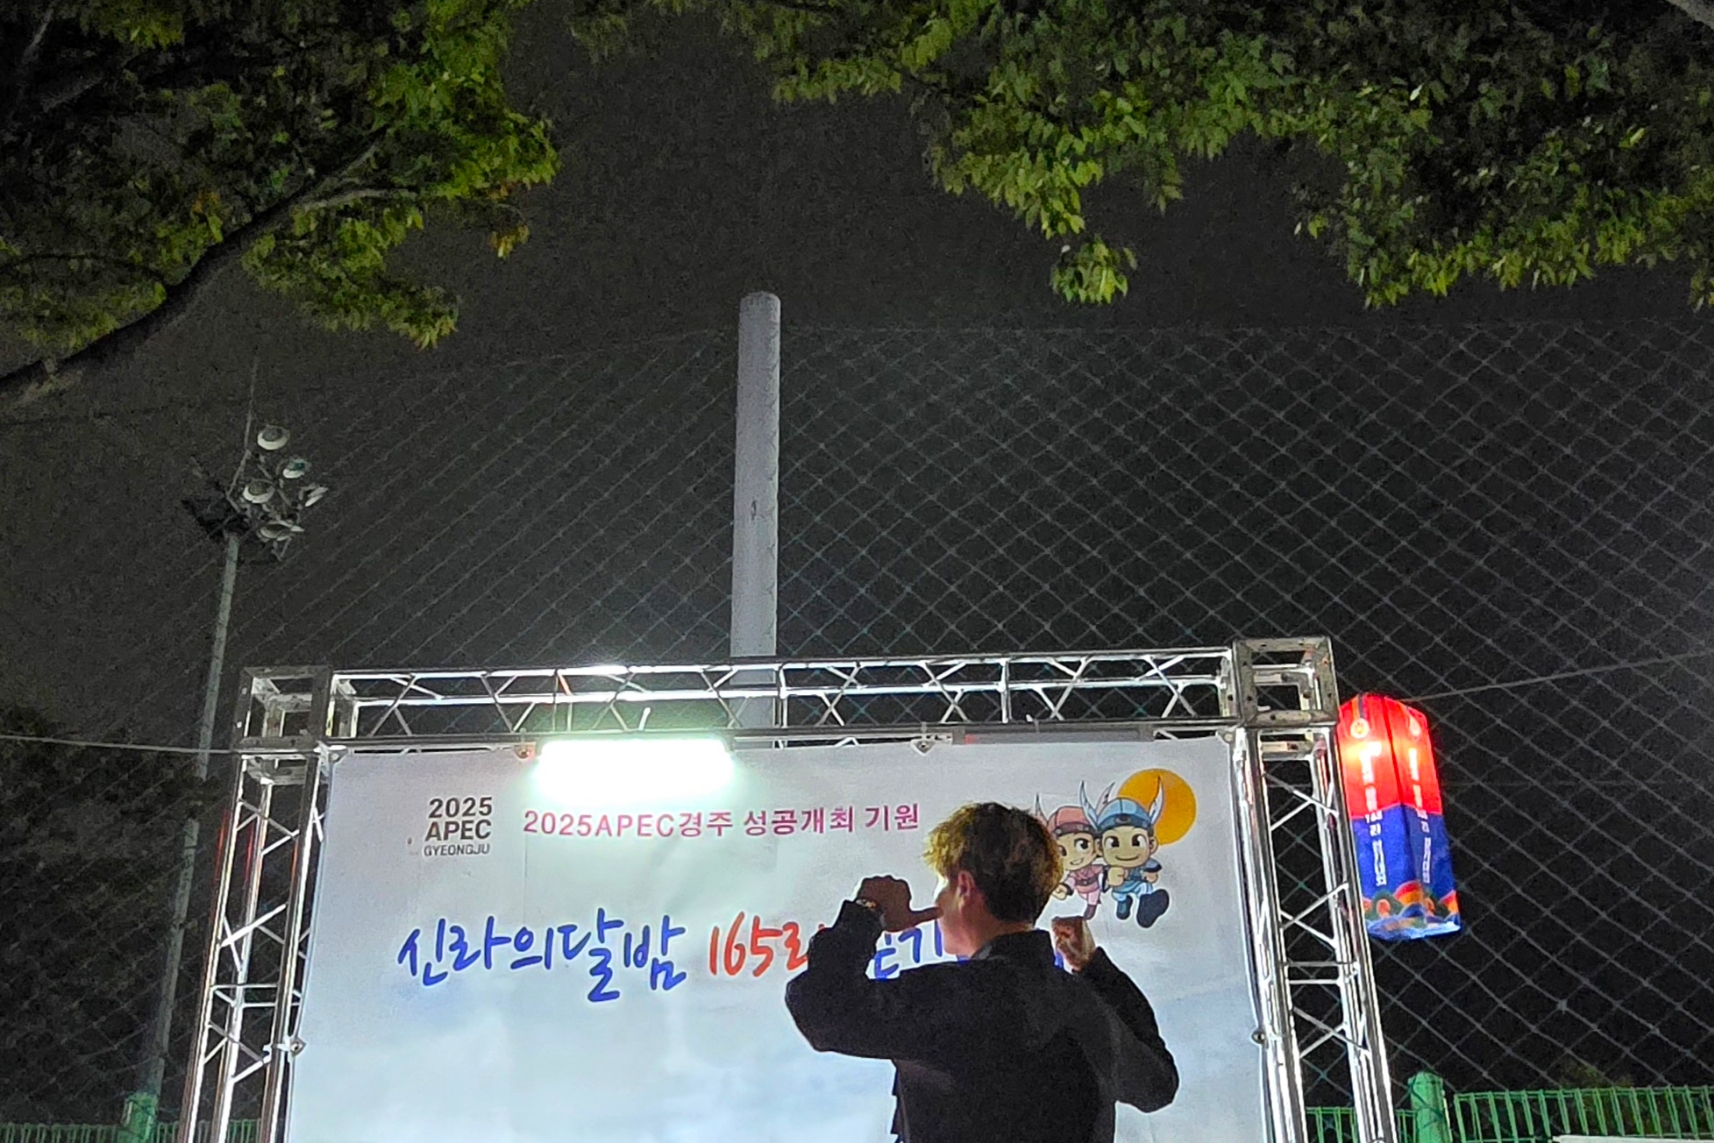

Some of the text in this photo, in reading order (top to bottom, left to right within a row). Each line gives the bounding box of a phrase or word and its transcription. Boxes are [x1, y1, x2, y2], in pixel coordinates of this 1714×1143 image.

[428, 796, 493, 819] 2025
[424, 819, 492, 842] APEC
[523, 803, 919, 838] 2025APEC경주 성공개최 기원
[423, 843, 491, 857] GYEONGJU
[397, 906, 688, 1003] 신라의달밤
